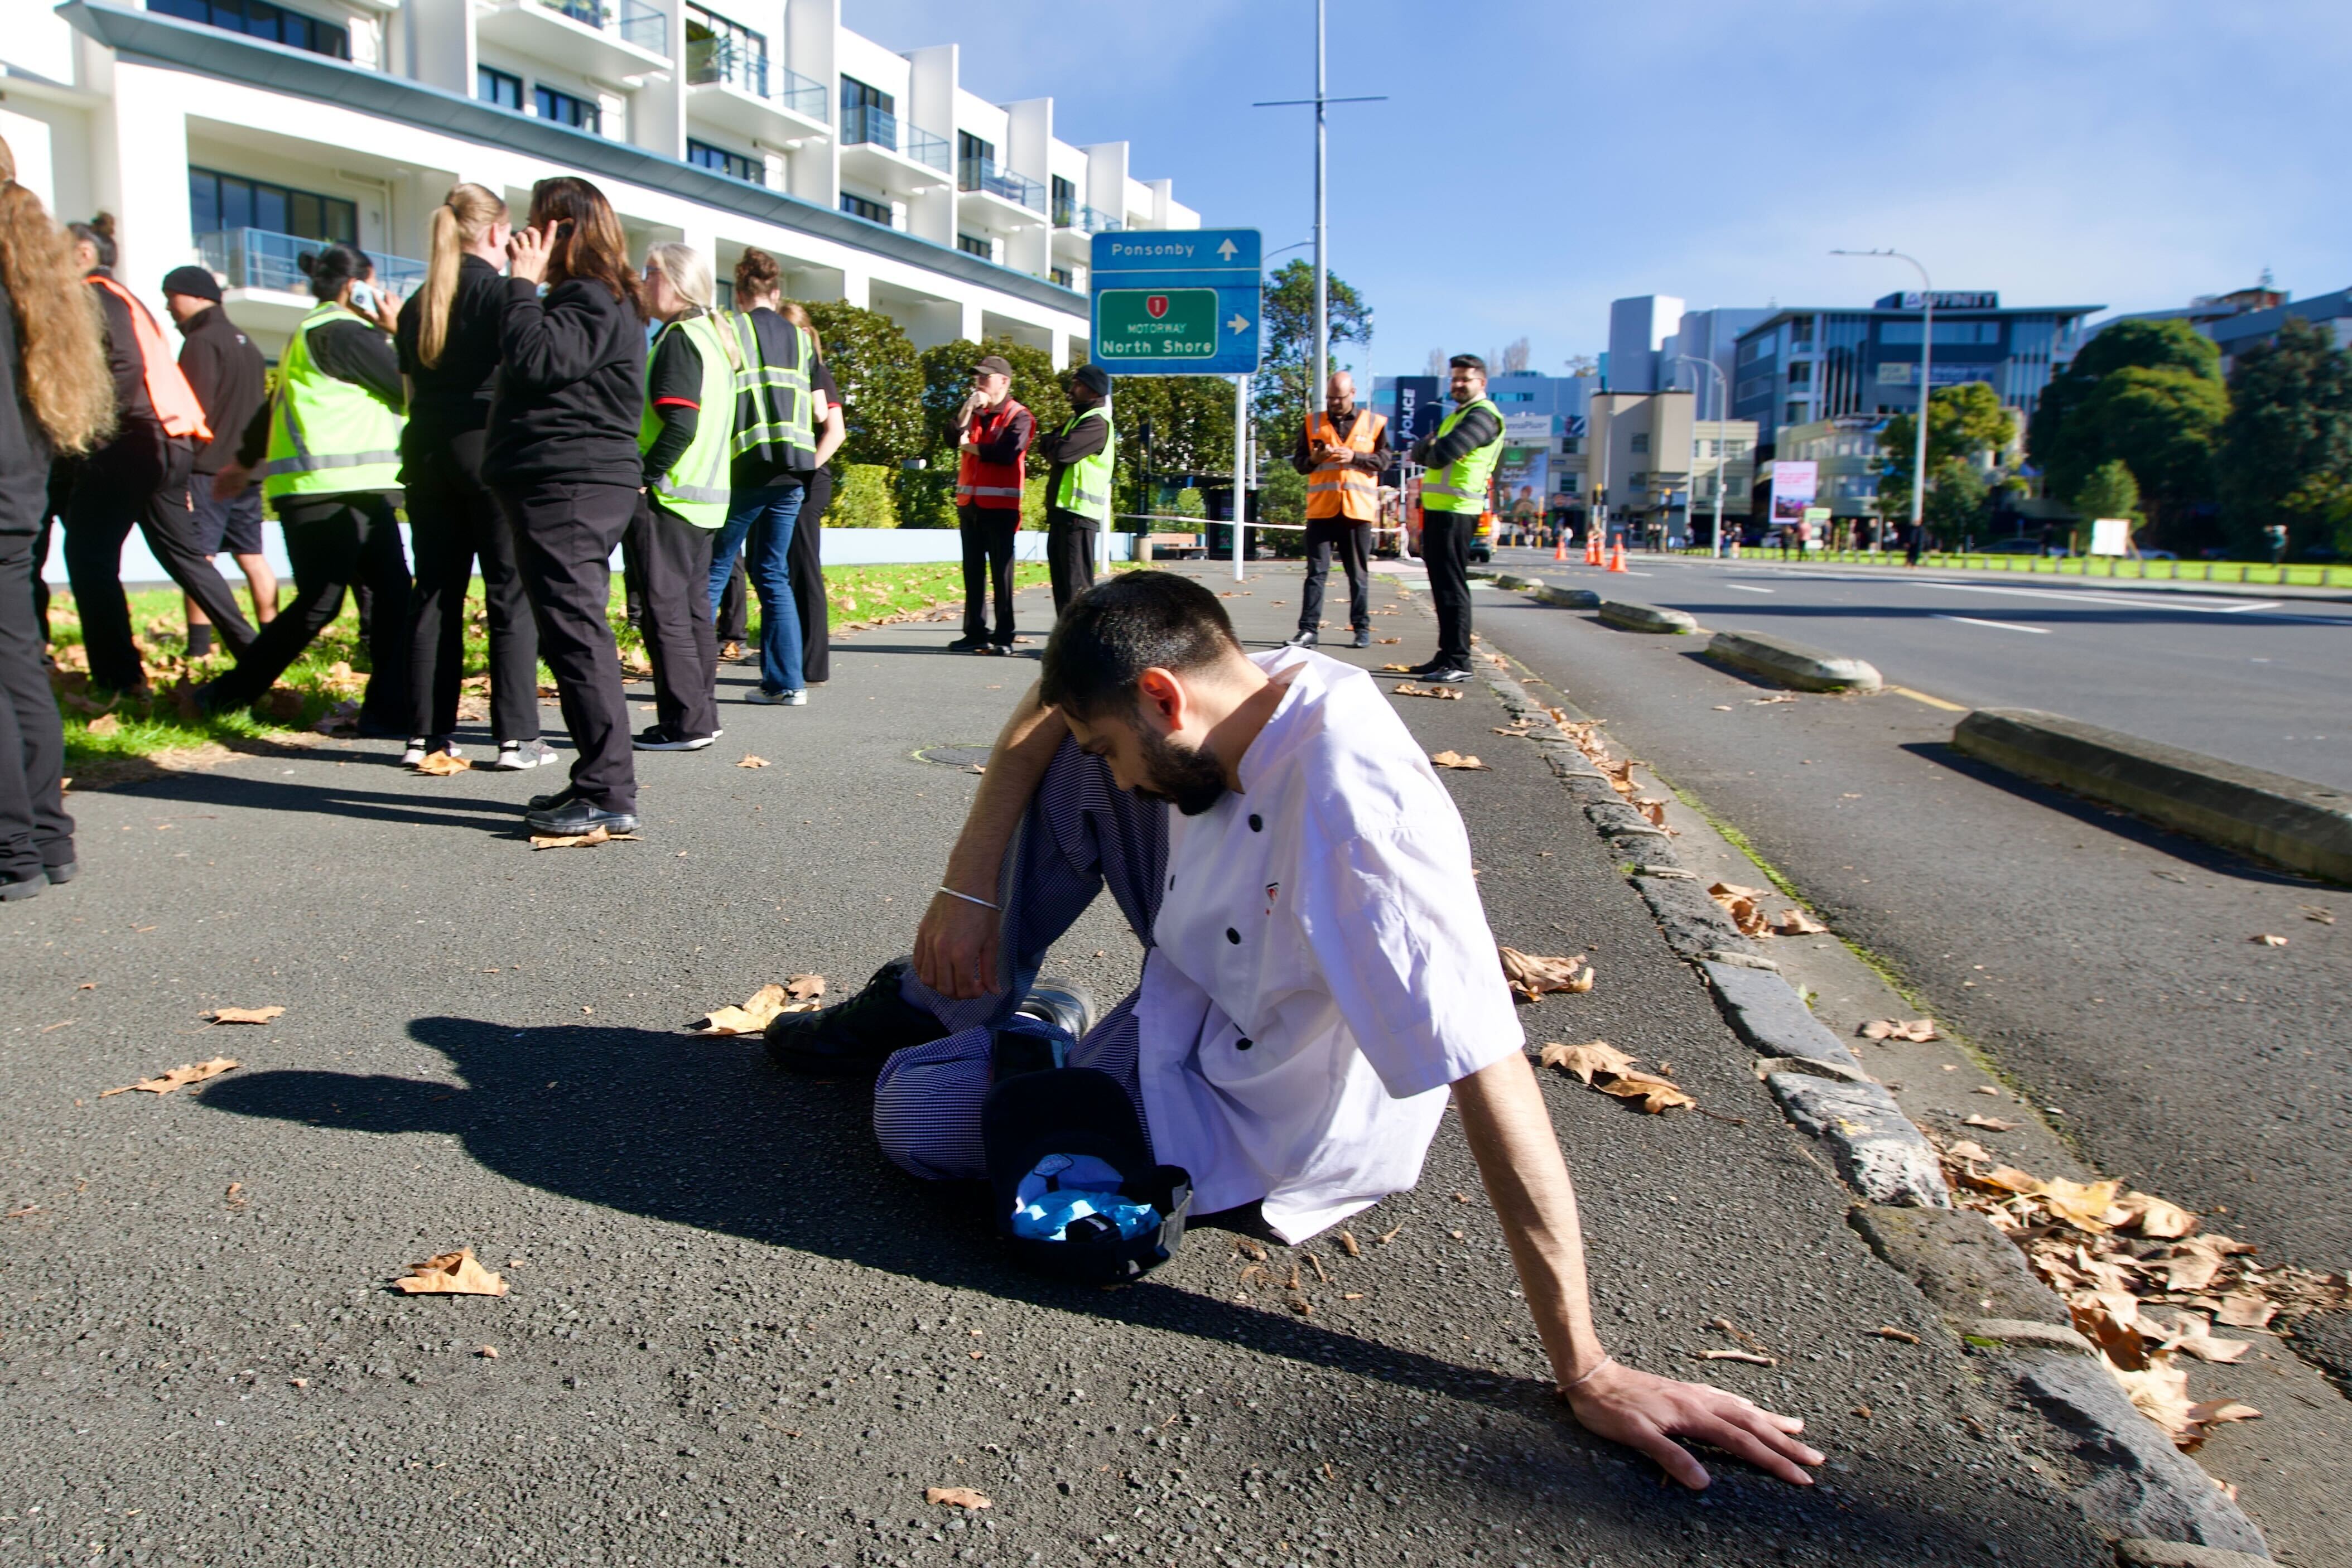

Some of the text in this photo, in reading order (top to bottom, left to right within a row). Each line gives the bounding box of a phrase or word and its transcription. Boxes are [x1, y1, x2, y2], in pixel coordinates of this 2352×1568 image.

[1111, 243, 1194, 258] Ponsonby
[1154, 300, 1160, 313] 1
[1127, 323, 1187, 334] MOTORWAY
[1102, 339, 1212, 353] North Shore
[1402, 388, 1415, 438] POLICE
